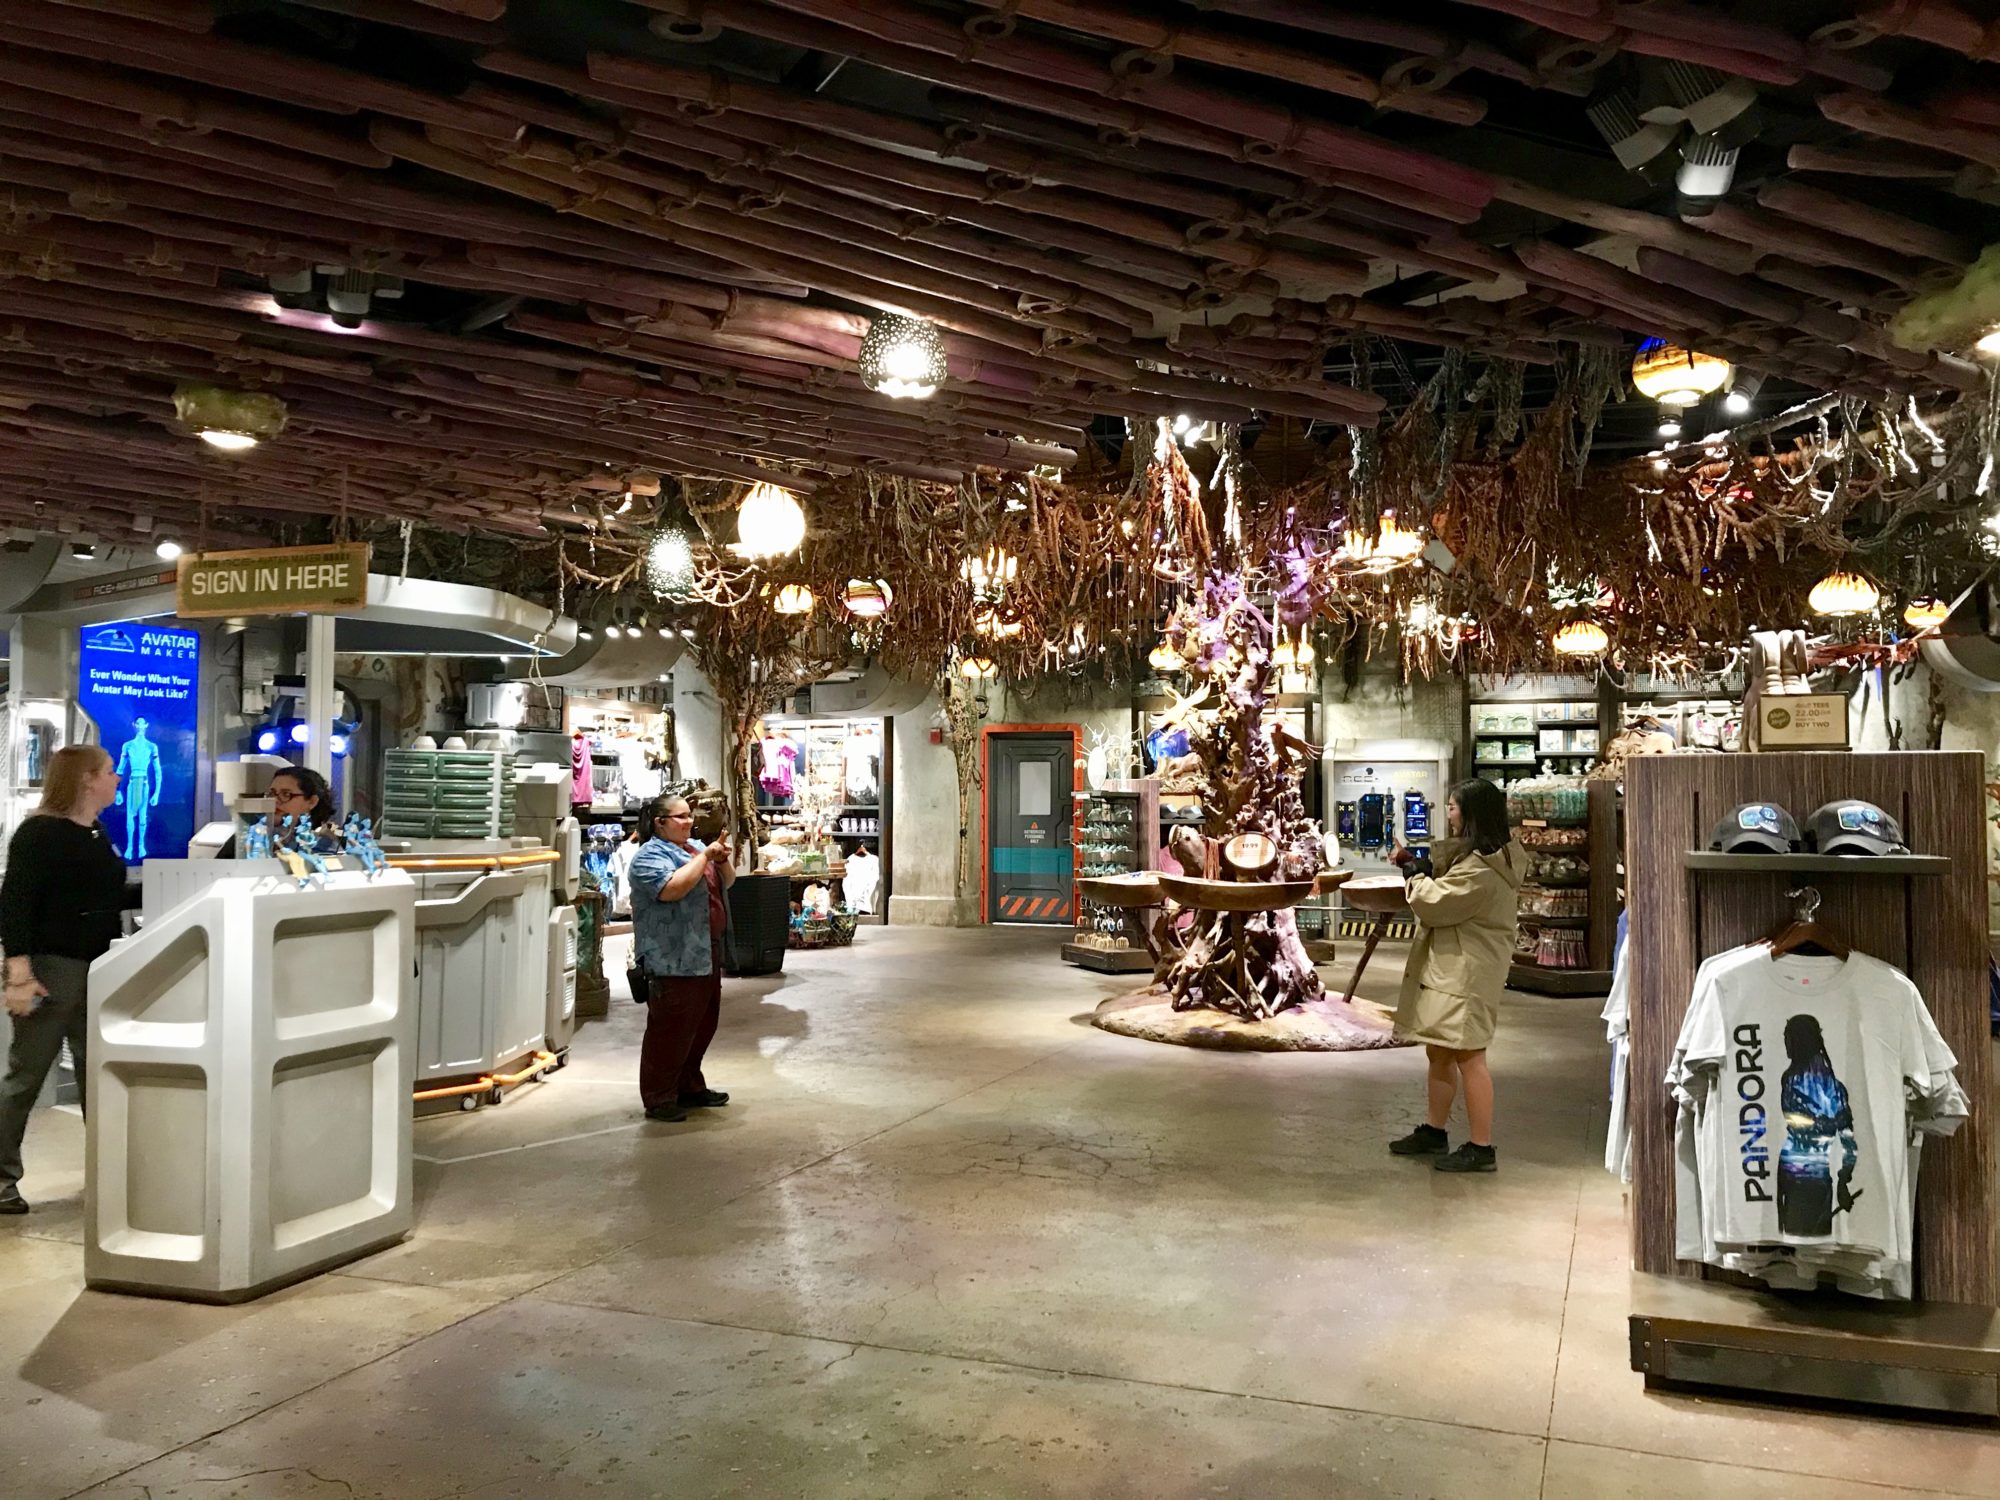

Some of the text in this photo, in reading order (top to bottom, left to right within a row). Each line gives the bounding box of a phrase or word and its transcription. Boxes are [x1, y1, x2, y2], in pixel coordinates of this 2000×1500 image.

[191, 564, 349, 596] SIGN IN HERE
[141, 632, 196, 650] AVATAR
[141, 646, 196, 659] MAKER
[90, 668, 191, 686] Ever Wonder What Your
[92, 683, 188, 699] Avatar May Look Like?
[1733, 1023, 1773, 1202] PANDORA
